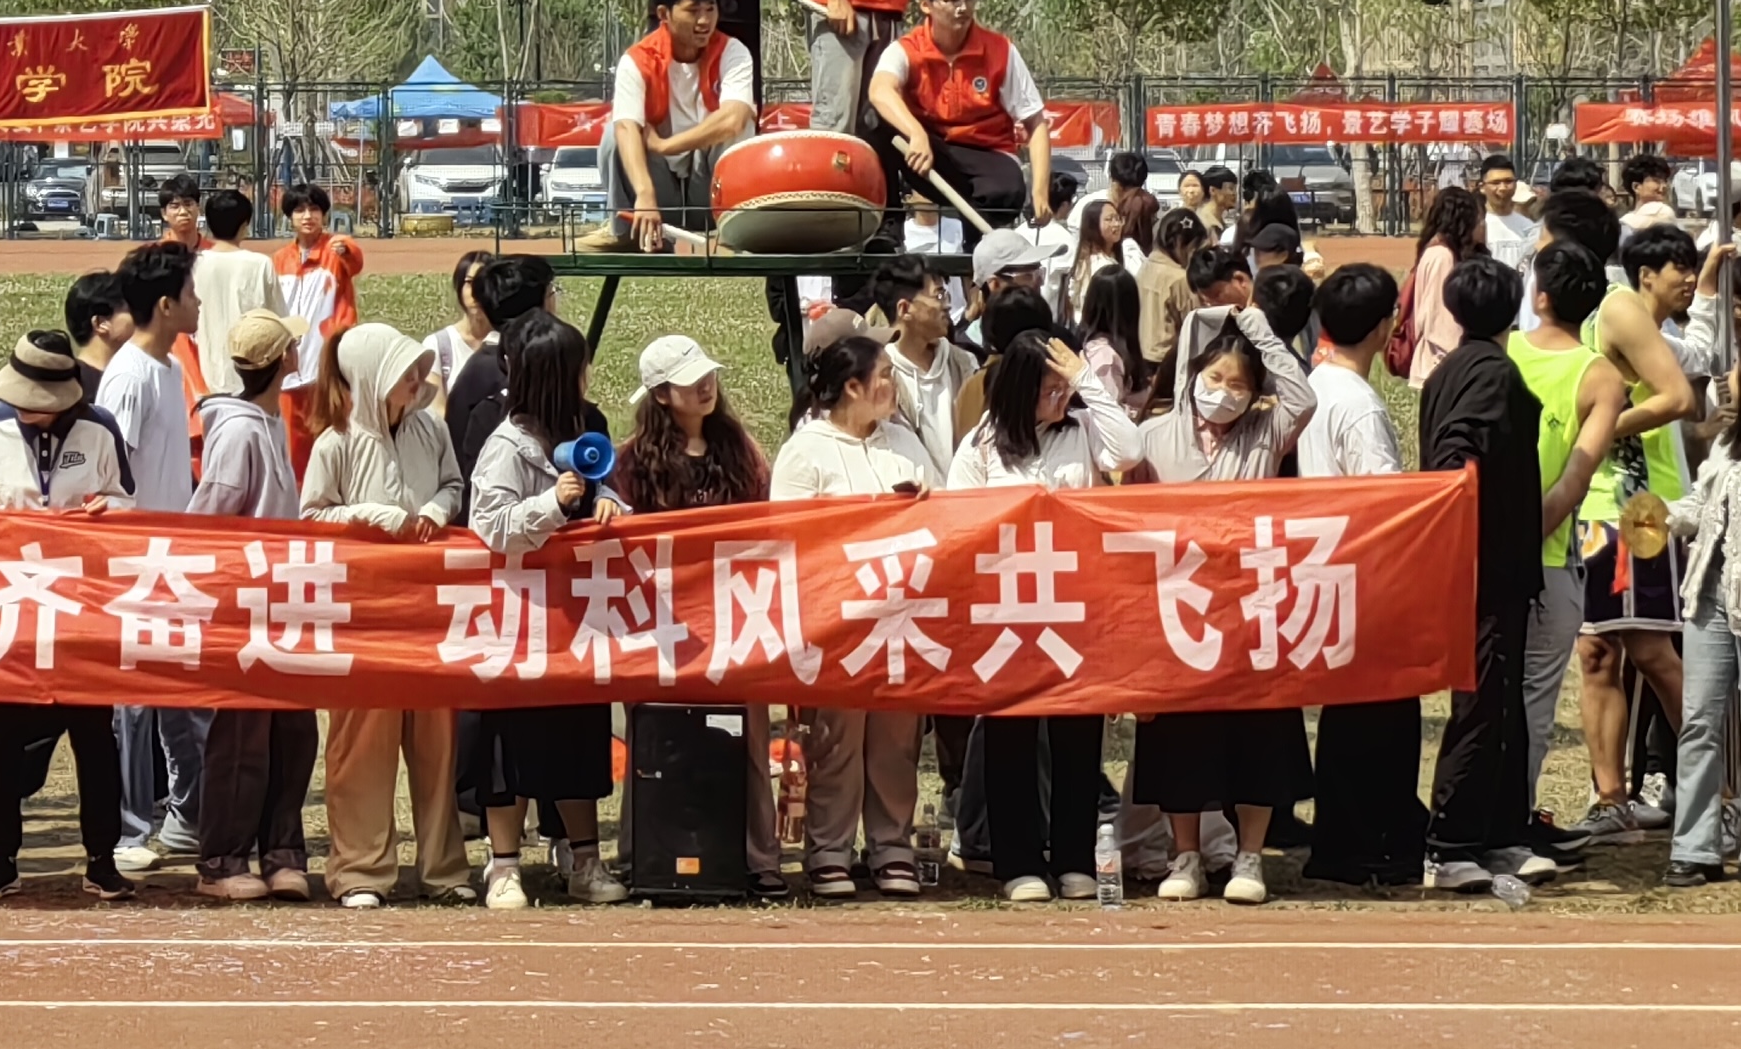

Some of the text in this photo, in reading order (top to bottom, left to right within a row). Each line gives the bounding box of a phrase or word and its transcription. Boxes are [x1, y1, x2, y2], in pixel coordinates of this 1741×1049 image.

[435, 513, 1358, 686] 动科风采共飞扬
